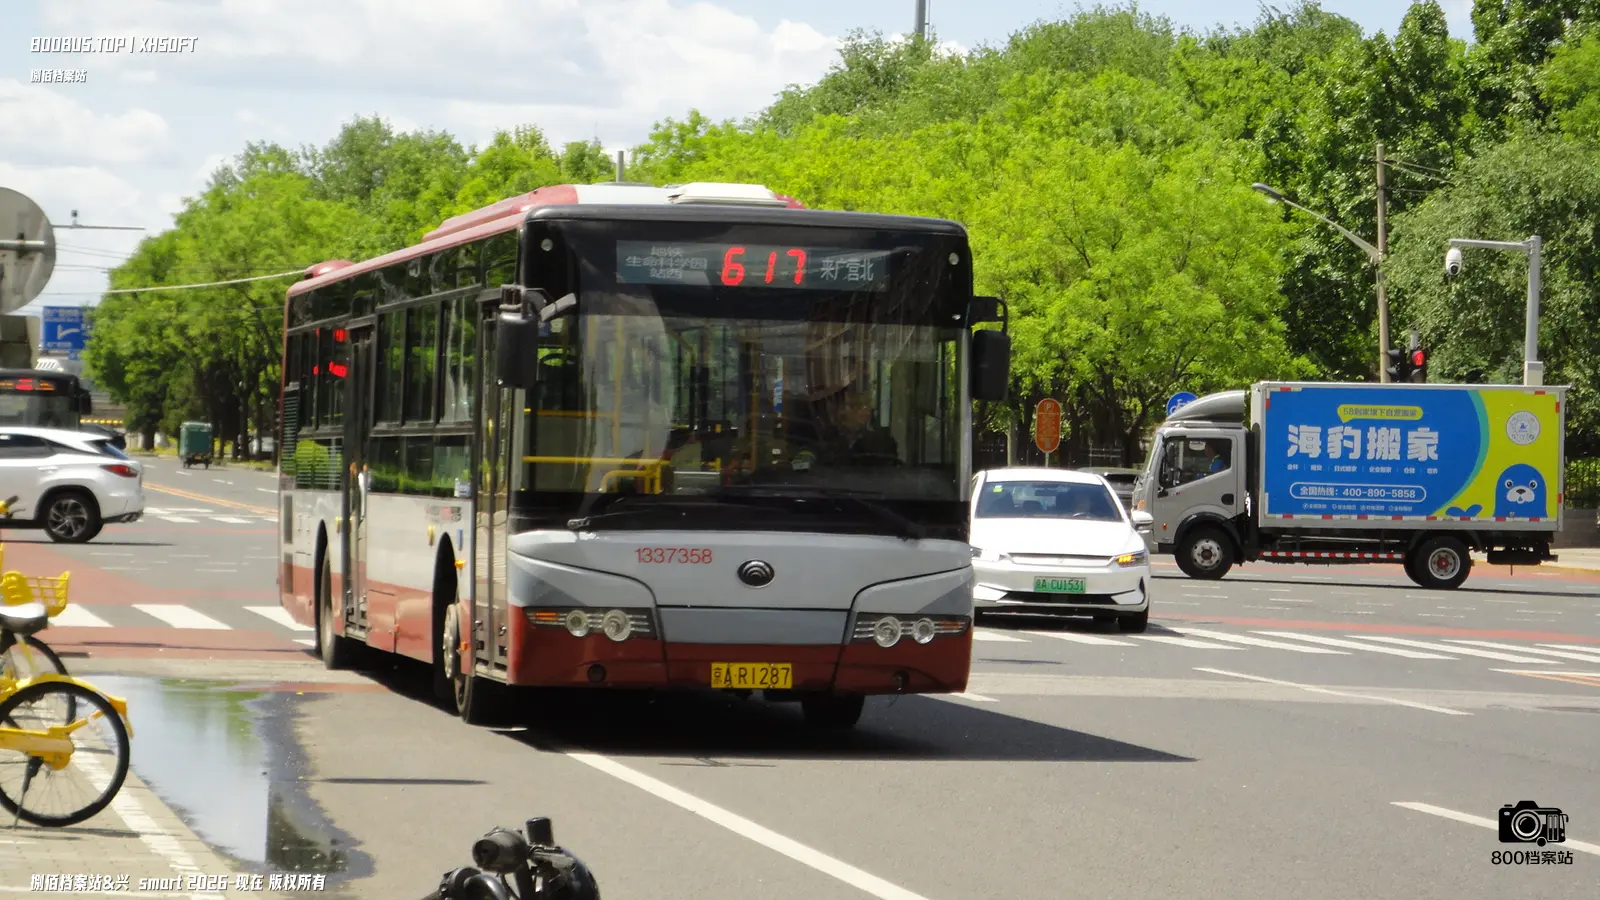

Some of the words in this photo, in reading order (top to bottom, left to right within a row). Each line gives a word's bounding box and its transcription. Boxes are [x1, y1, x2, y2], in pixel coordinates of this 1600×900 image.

[721, 247, 807, 285] 617
[820, 257, 874, 281] 来广营北
[1287, 424, 1439, 461] 海豹搬家
[1342, 487, 1416, 499] 400-890-5858
[634, 547, 713, 564] 1337358
